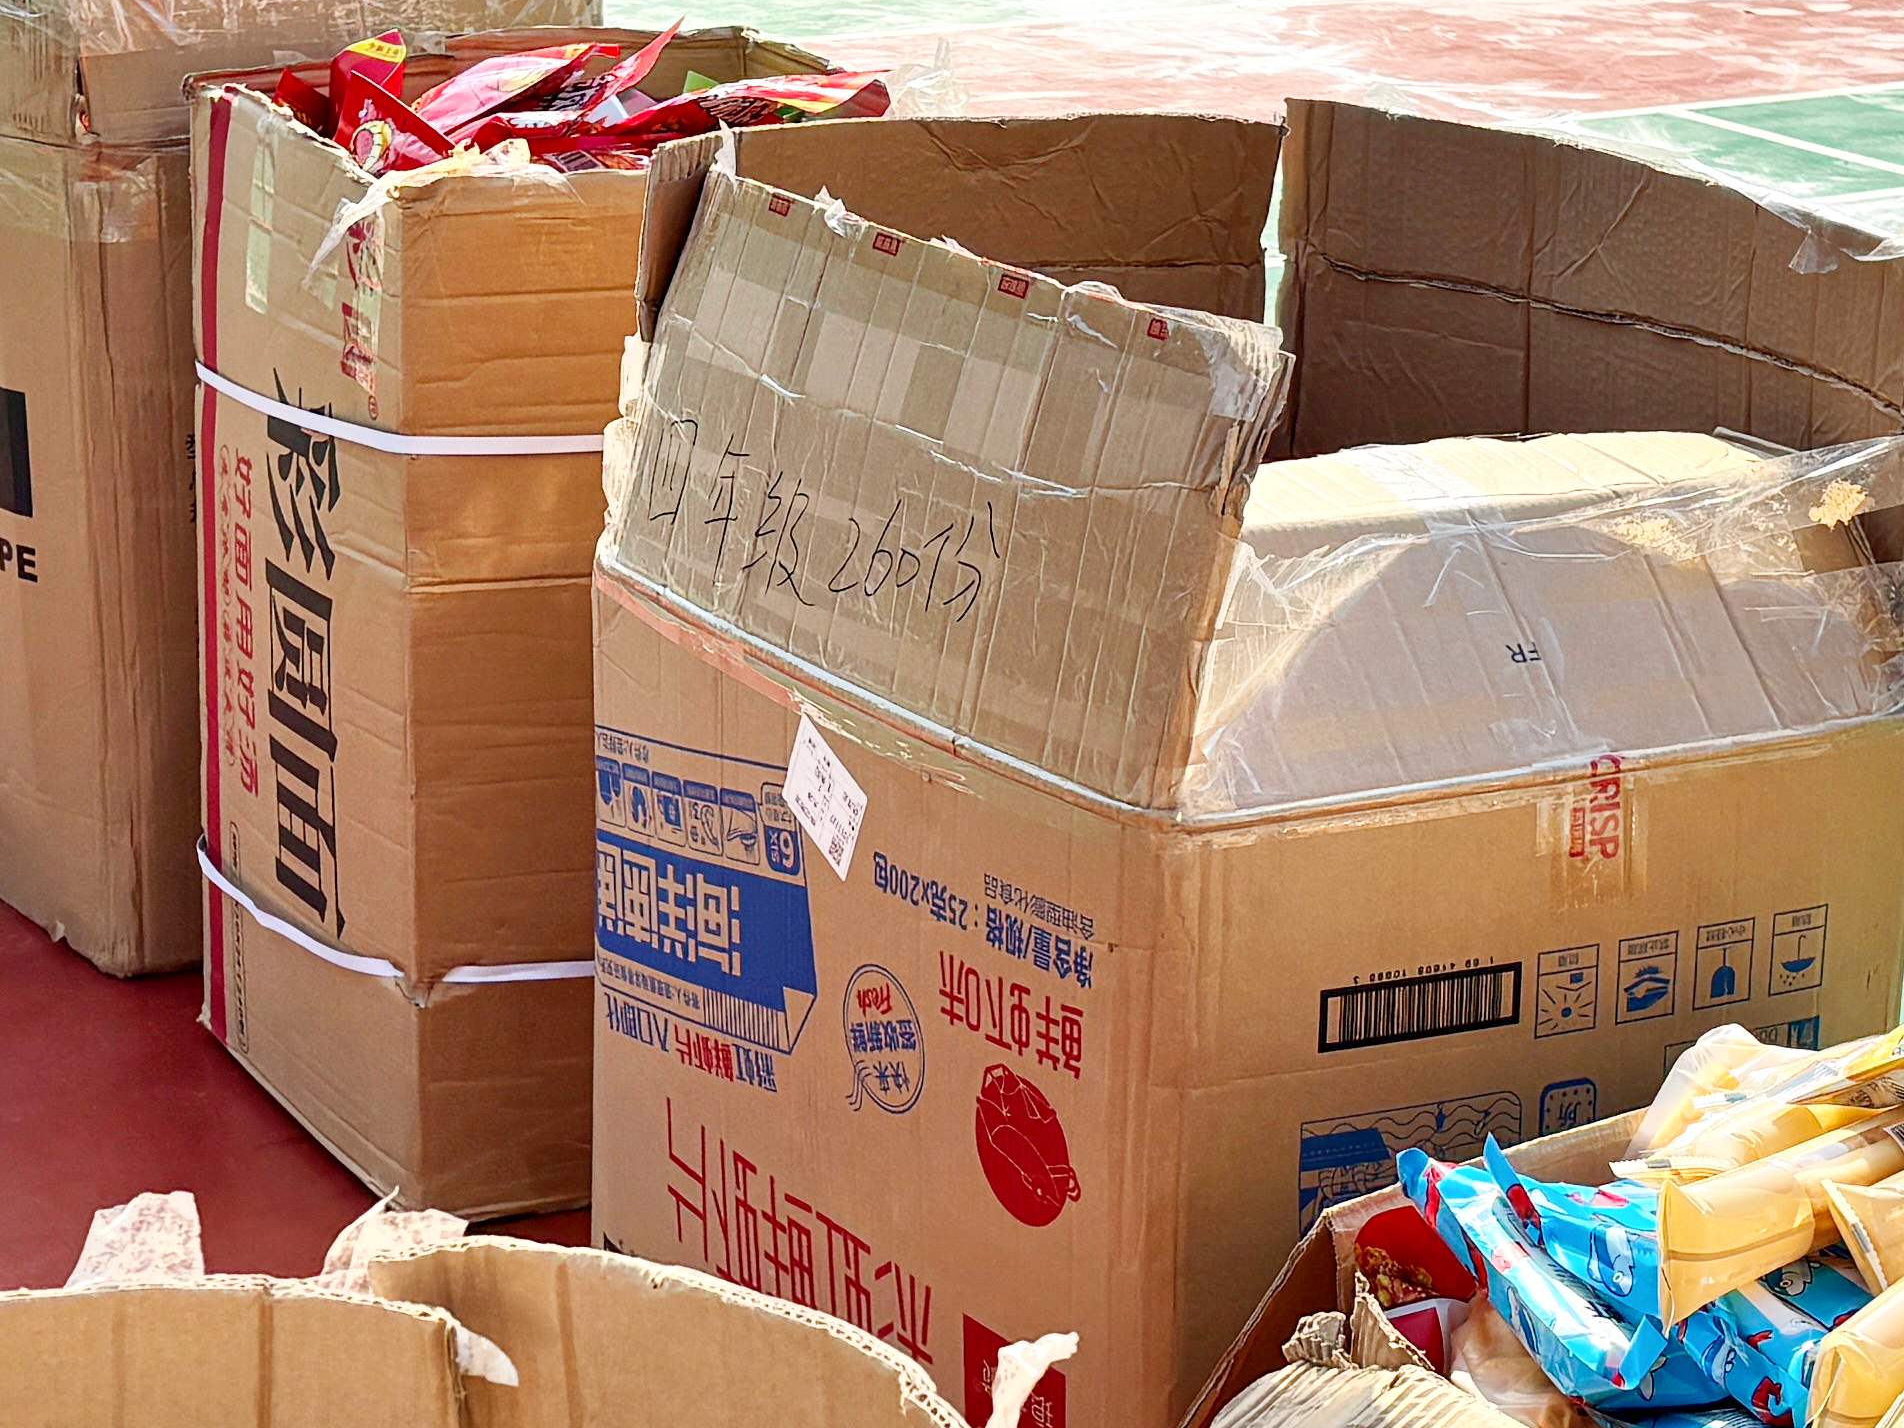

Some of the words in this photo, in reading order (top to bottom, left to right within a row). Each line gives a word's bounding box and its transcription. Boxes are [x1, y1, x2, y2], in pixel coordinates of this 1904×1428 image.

[1588, 753, 1623, 860] CRISP
[856, 983, 893, 1015] Fresh
[938, 950, 1084, 1080] 鲜虾味
[871, 1059, 910, 1094] 快来
